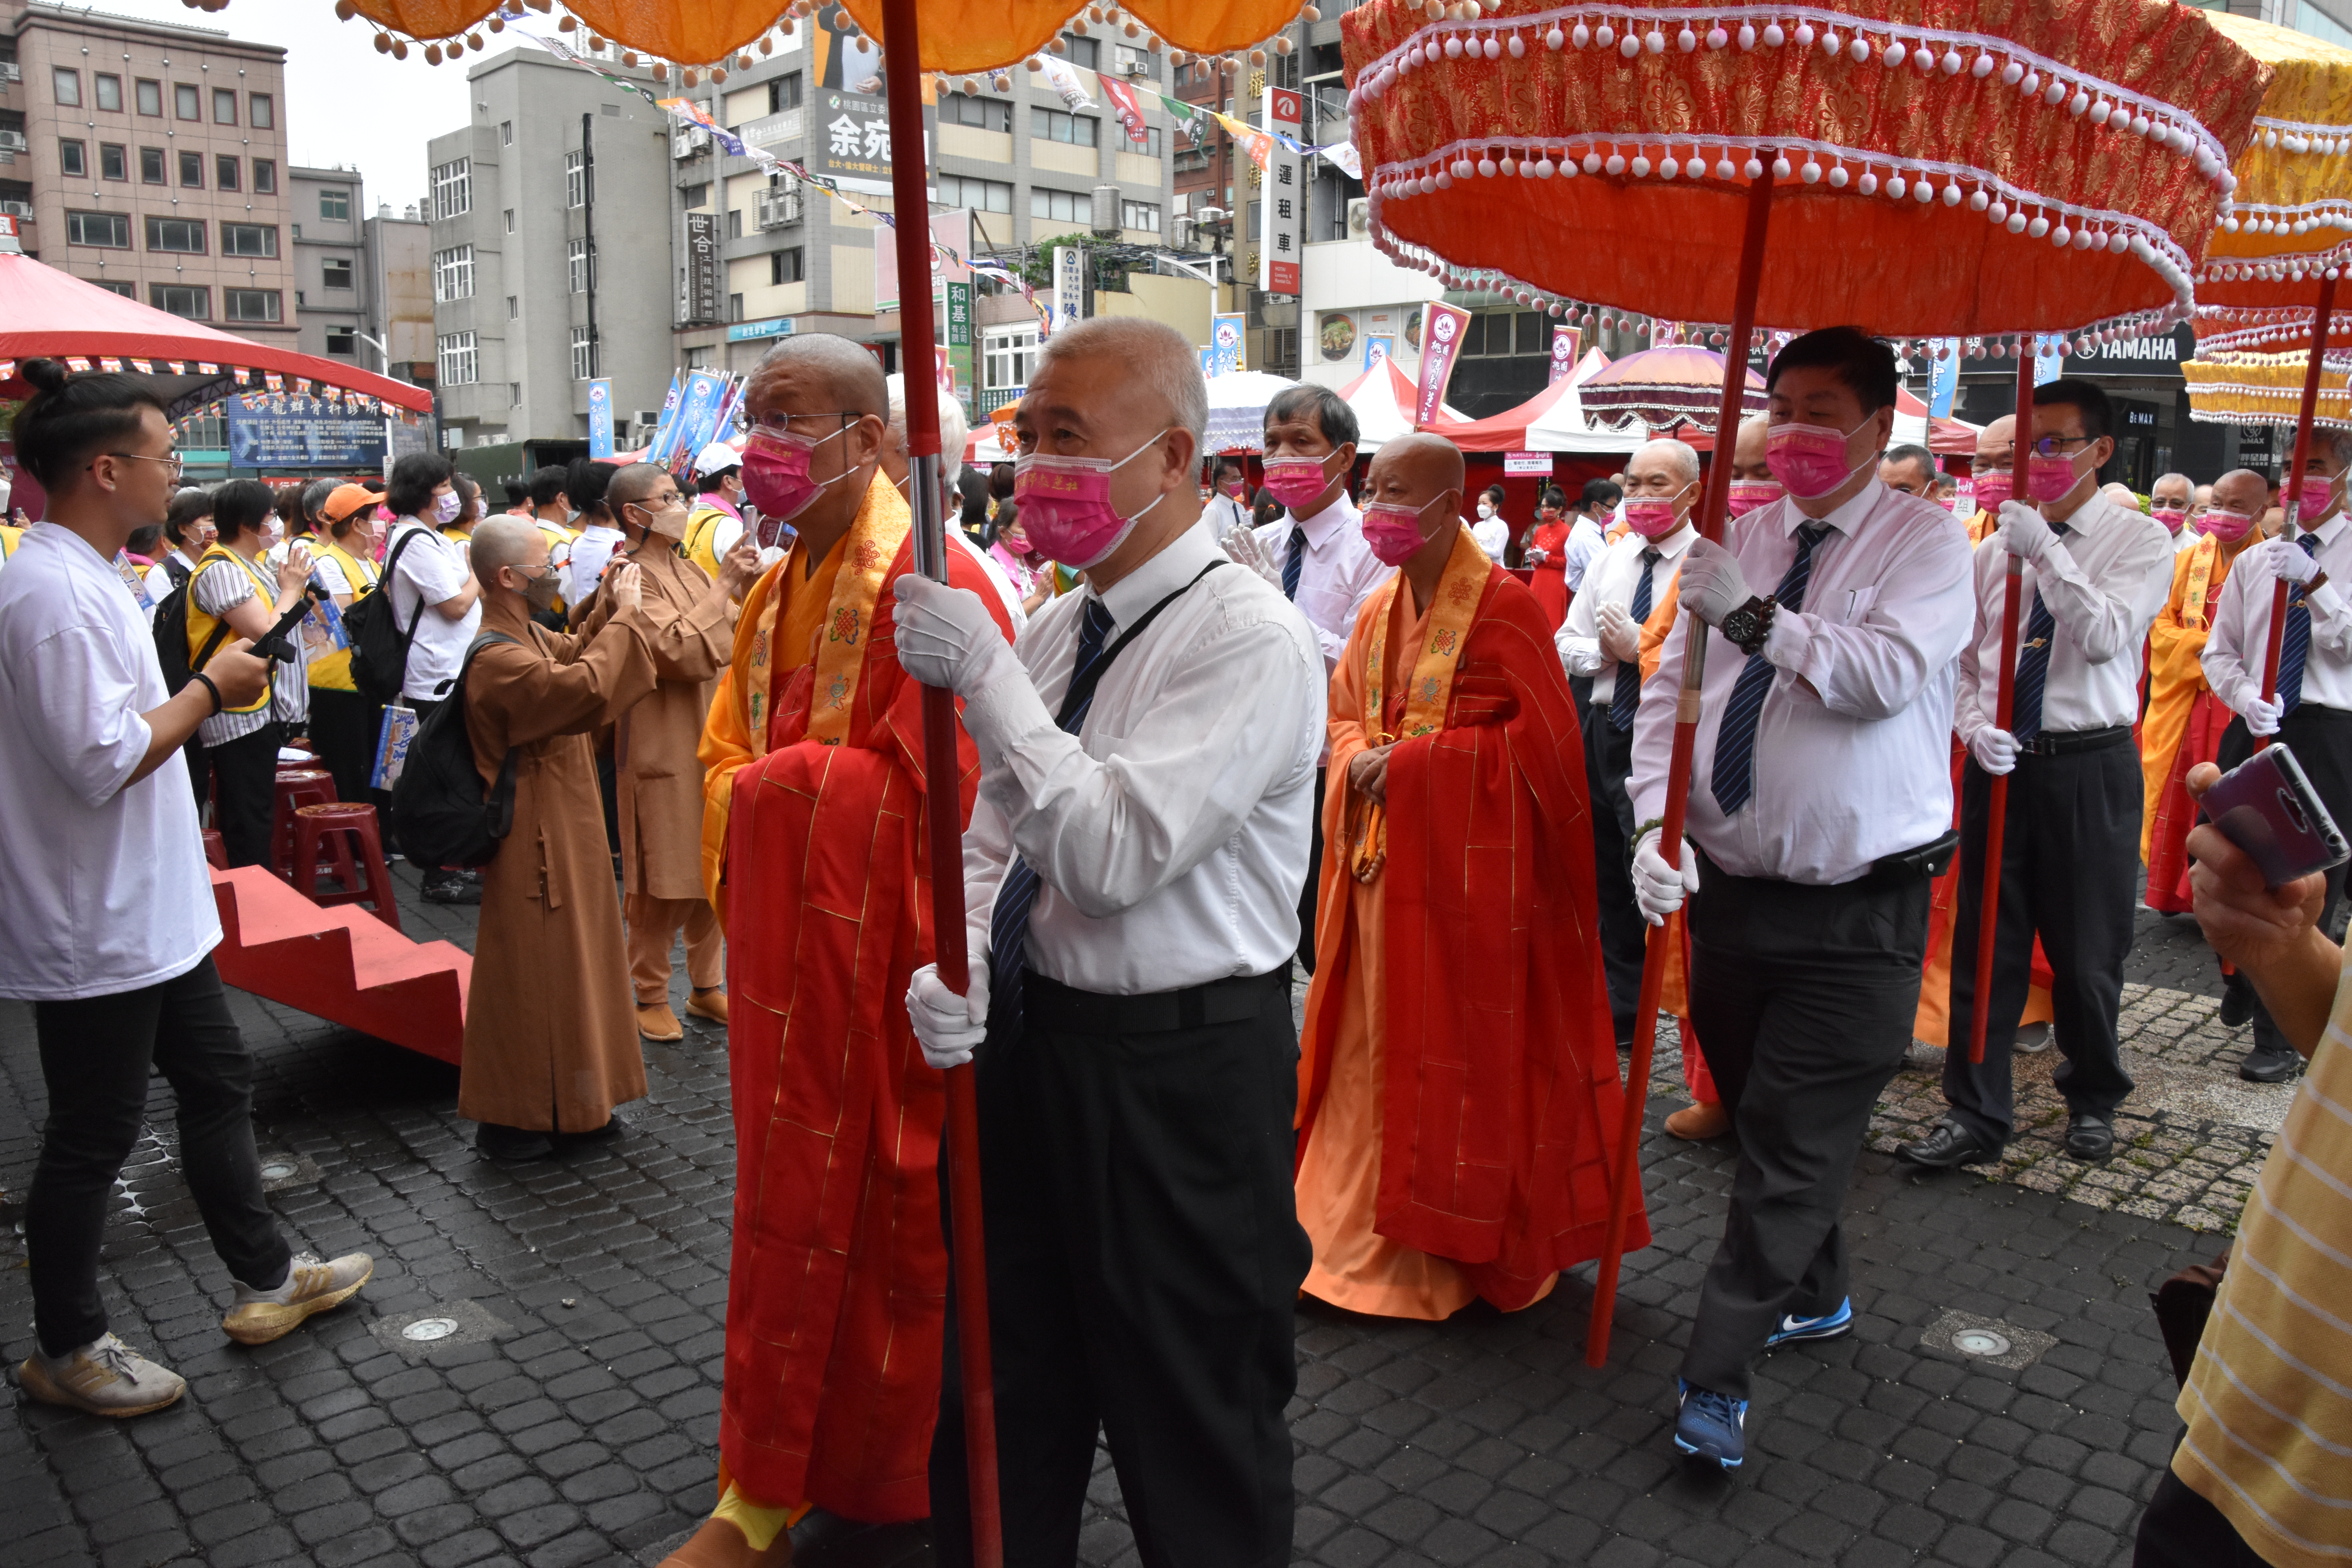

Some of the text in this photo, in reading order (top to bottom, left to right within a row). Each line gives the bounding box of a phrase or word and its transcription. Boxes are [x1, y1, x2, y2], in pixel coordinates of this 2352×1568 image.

[843, 100, 889, 114] 桃園區立委
[689, 215, 712, 252] 世合
[951, 286, 966, 322] 和基
[2101, 338, 2176, 360] YAMAHA
[2138, 412, 2153, 425] MAX
